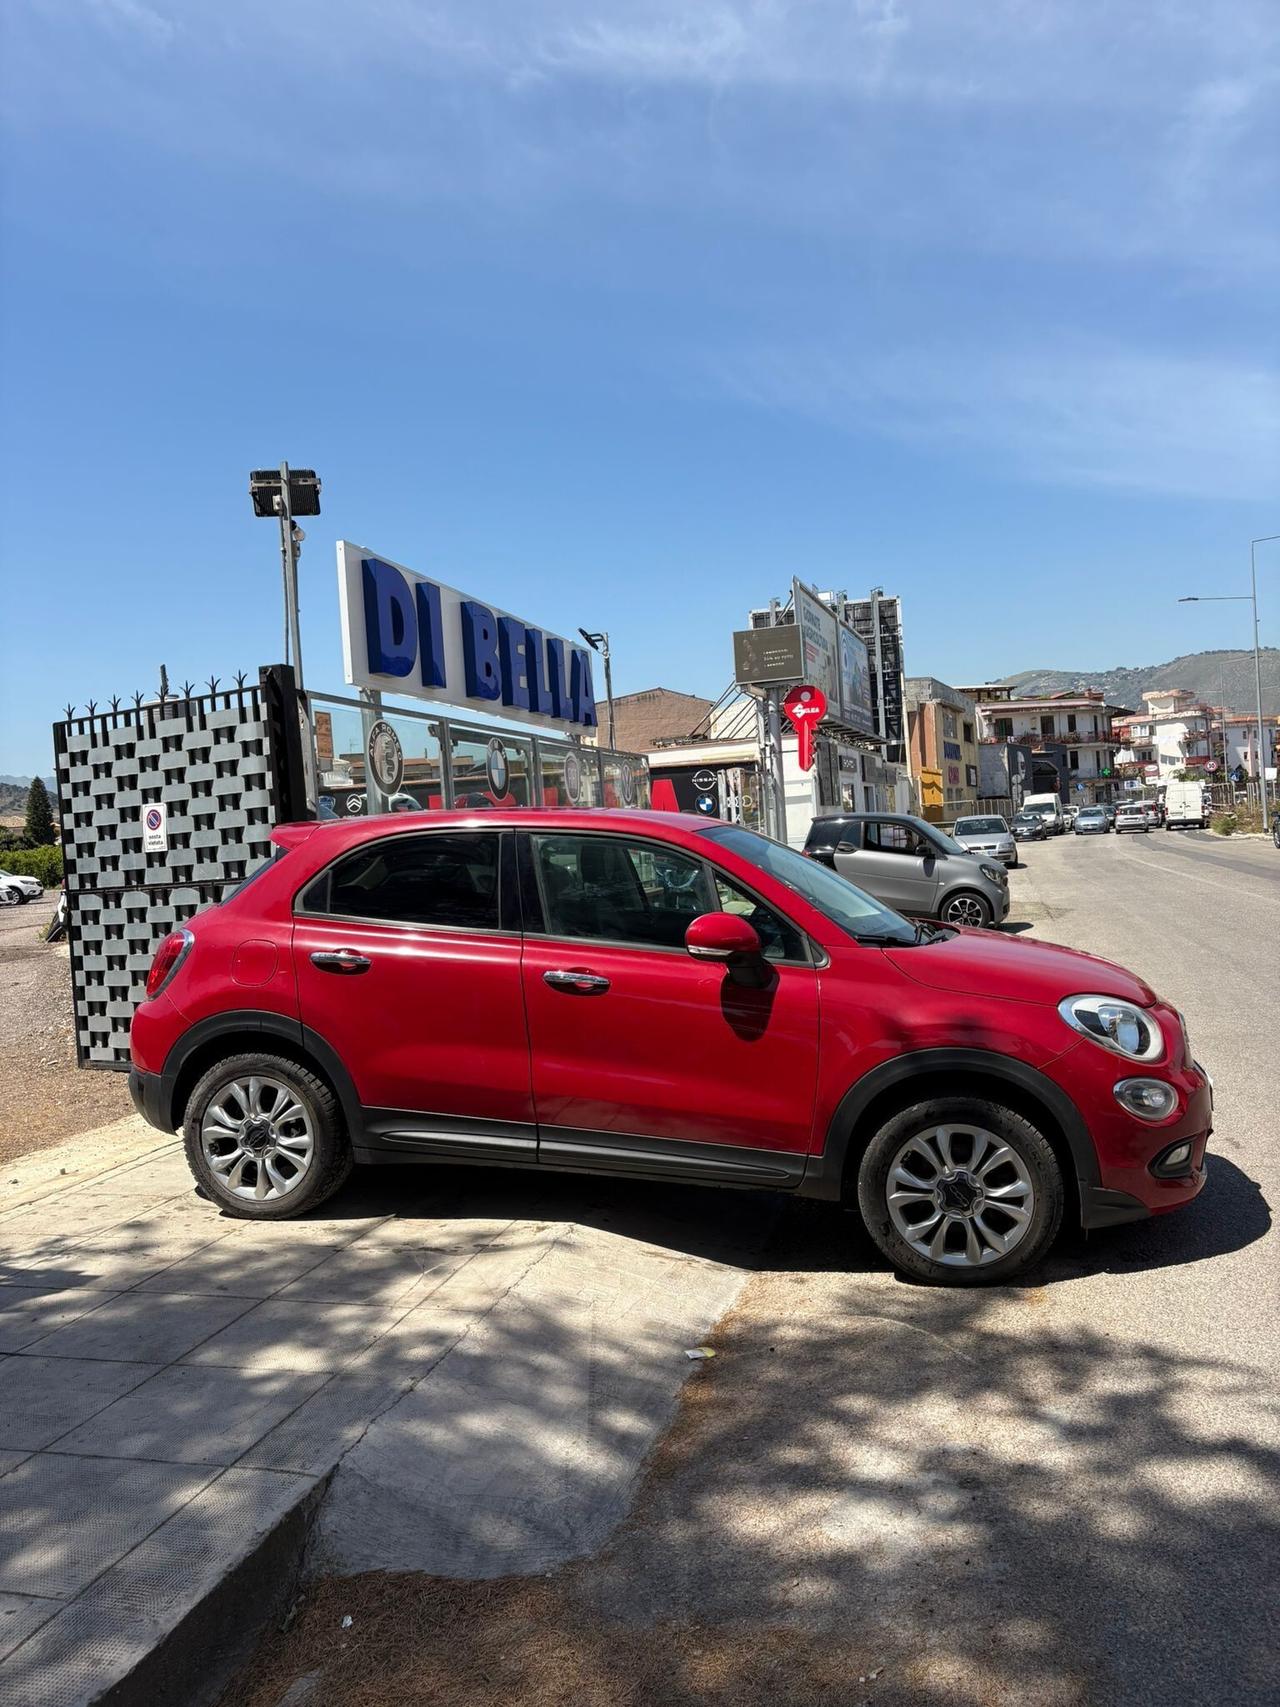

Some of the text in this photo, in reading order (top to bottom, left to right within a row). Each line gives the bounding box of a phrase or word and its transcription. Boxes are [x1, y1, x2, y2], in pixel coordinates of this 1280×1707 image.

[362, 558, 597, 727] DI BELLA
[382, 723, 402, 761] ROMEO
